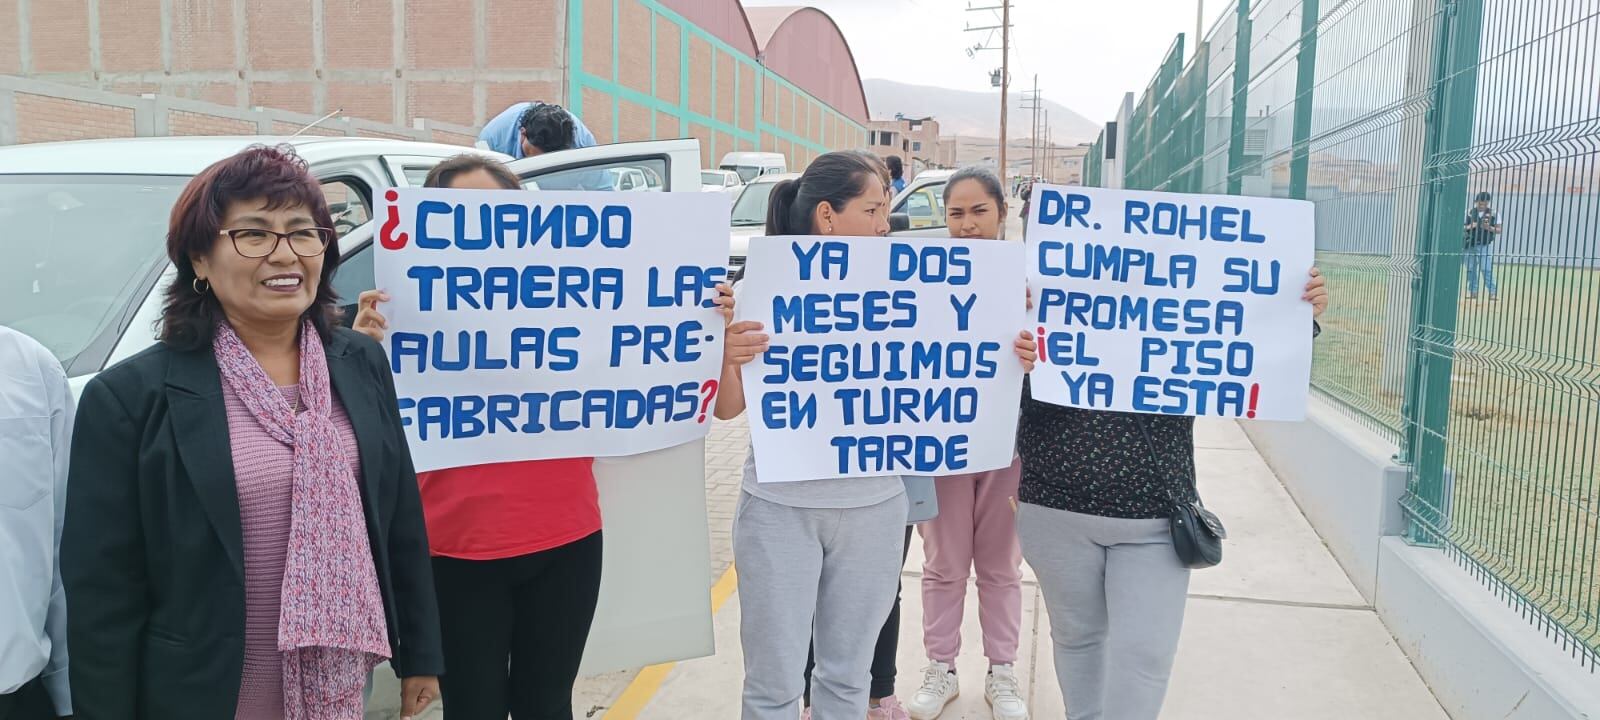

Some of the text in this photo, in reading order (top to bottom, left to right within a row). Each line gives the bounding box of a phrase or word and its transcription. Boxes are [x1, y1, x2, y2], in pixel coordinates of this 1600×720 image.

[1038, 189, 1266, 244] DR. ROHEL
[791, 241, 972, 286] YA DOS
[1038, 240, 1281, 296] CUMPLA SU
[407, 265, 727, 311] TRAERA LAS
[772, 290, 977, 334] MESES Y
[1037, 288, 1245, 336] PROMESA
[390, 320, 714, 374] AULAS PRE-
[762, 341, 1001, 384] SEGUIMOS
[1037, 326, 1254, 377] ¡EL PISO
[761, 386, 978, 429] EN TURNO
[1061, 371, 1260, 419] YA ESTA!
[830, 434, 969, 474] TARDE
